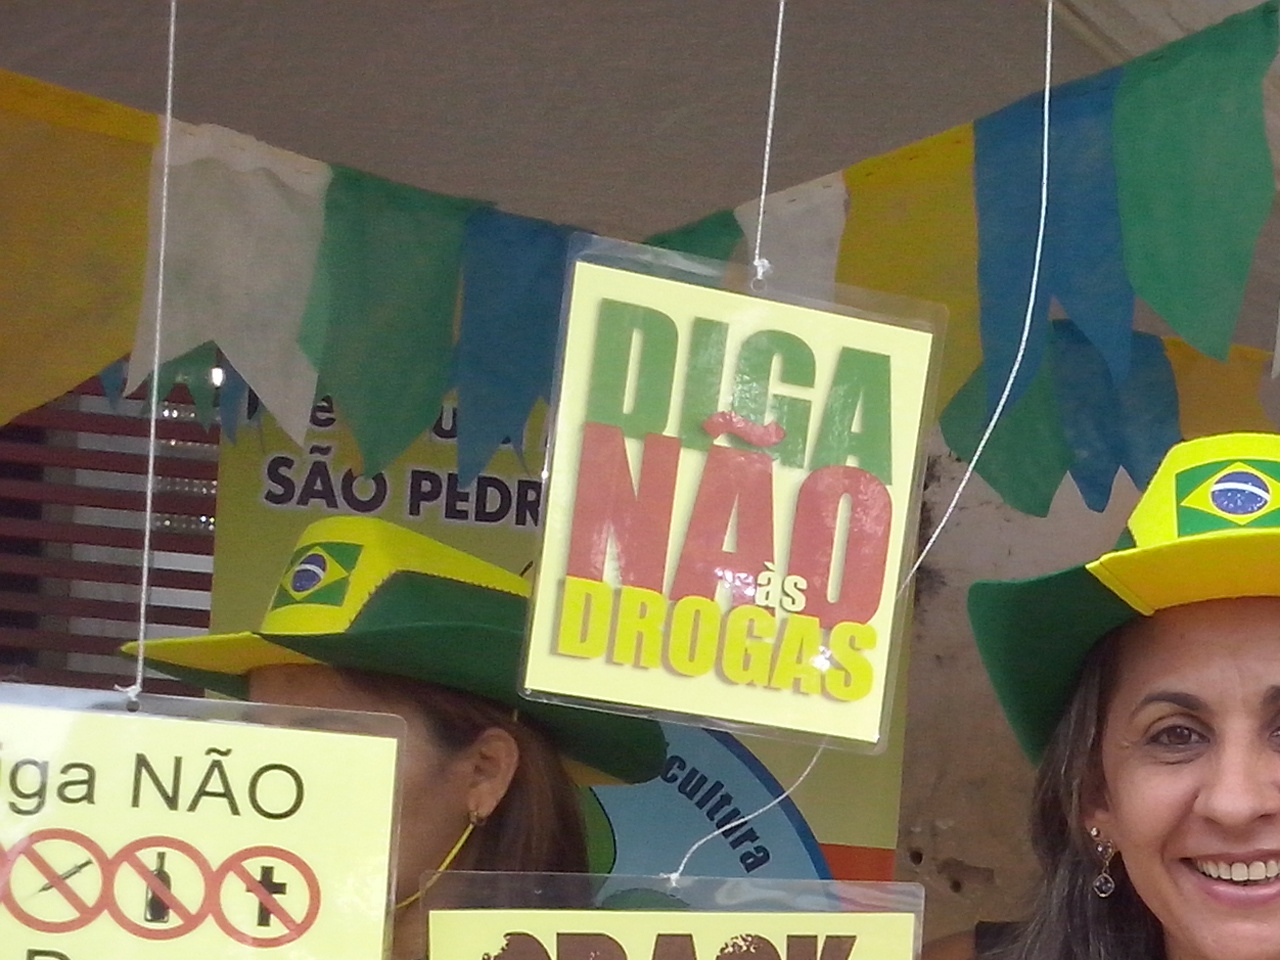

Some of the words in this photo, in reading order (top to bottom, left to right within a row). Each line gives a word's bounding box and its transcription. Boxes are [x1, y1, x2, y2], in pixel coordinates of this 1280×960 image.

[586, 298, 893, 485] DIGA
[264, 444, 388, 513] SÃO
[566, 411, 893, 627] NÃO
[556, 575, 878, 702] DROGAS
[755, 562, 808, 612] às
[0, 742, 96, 816] ga
[131, 747, 305, 820] NÃO
[660, 754, 773, 874] cultura
